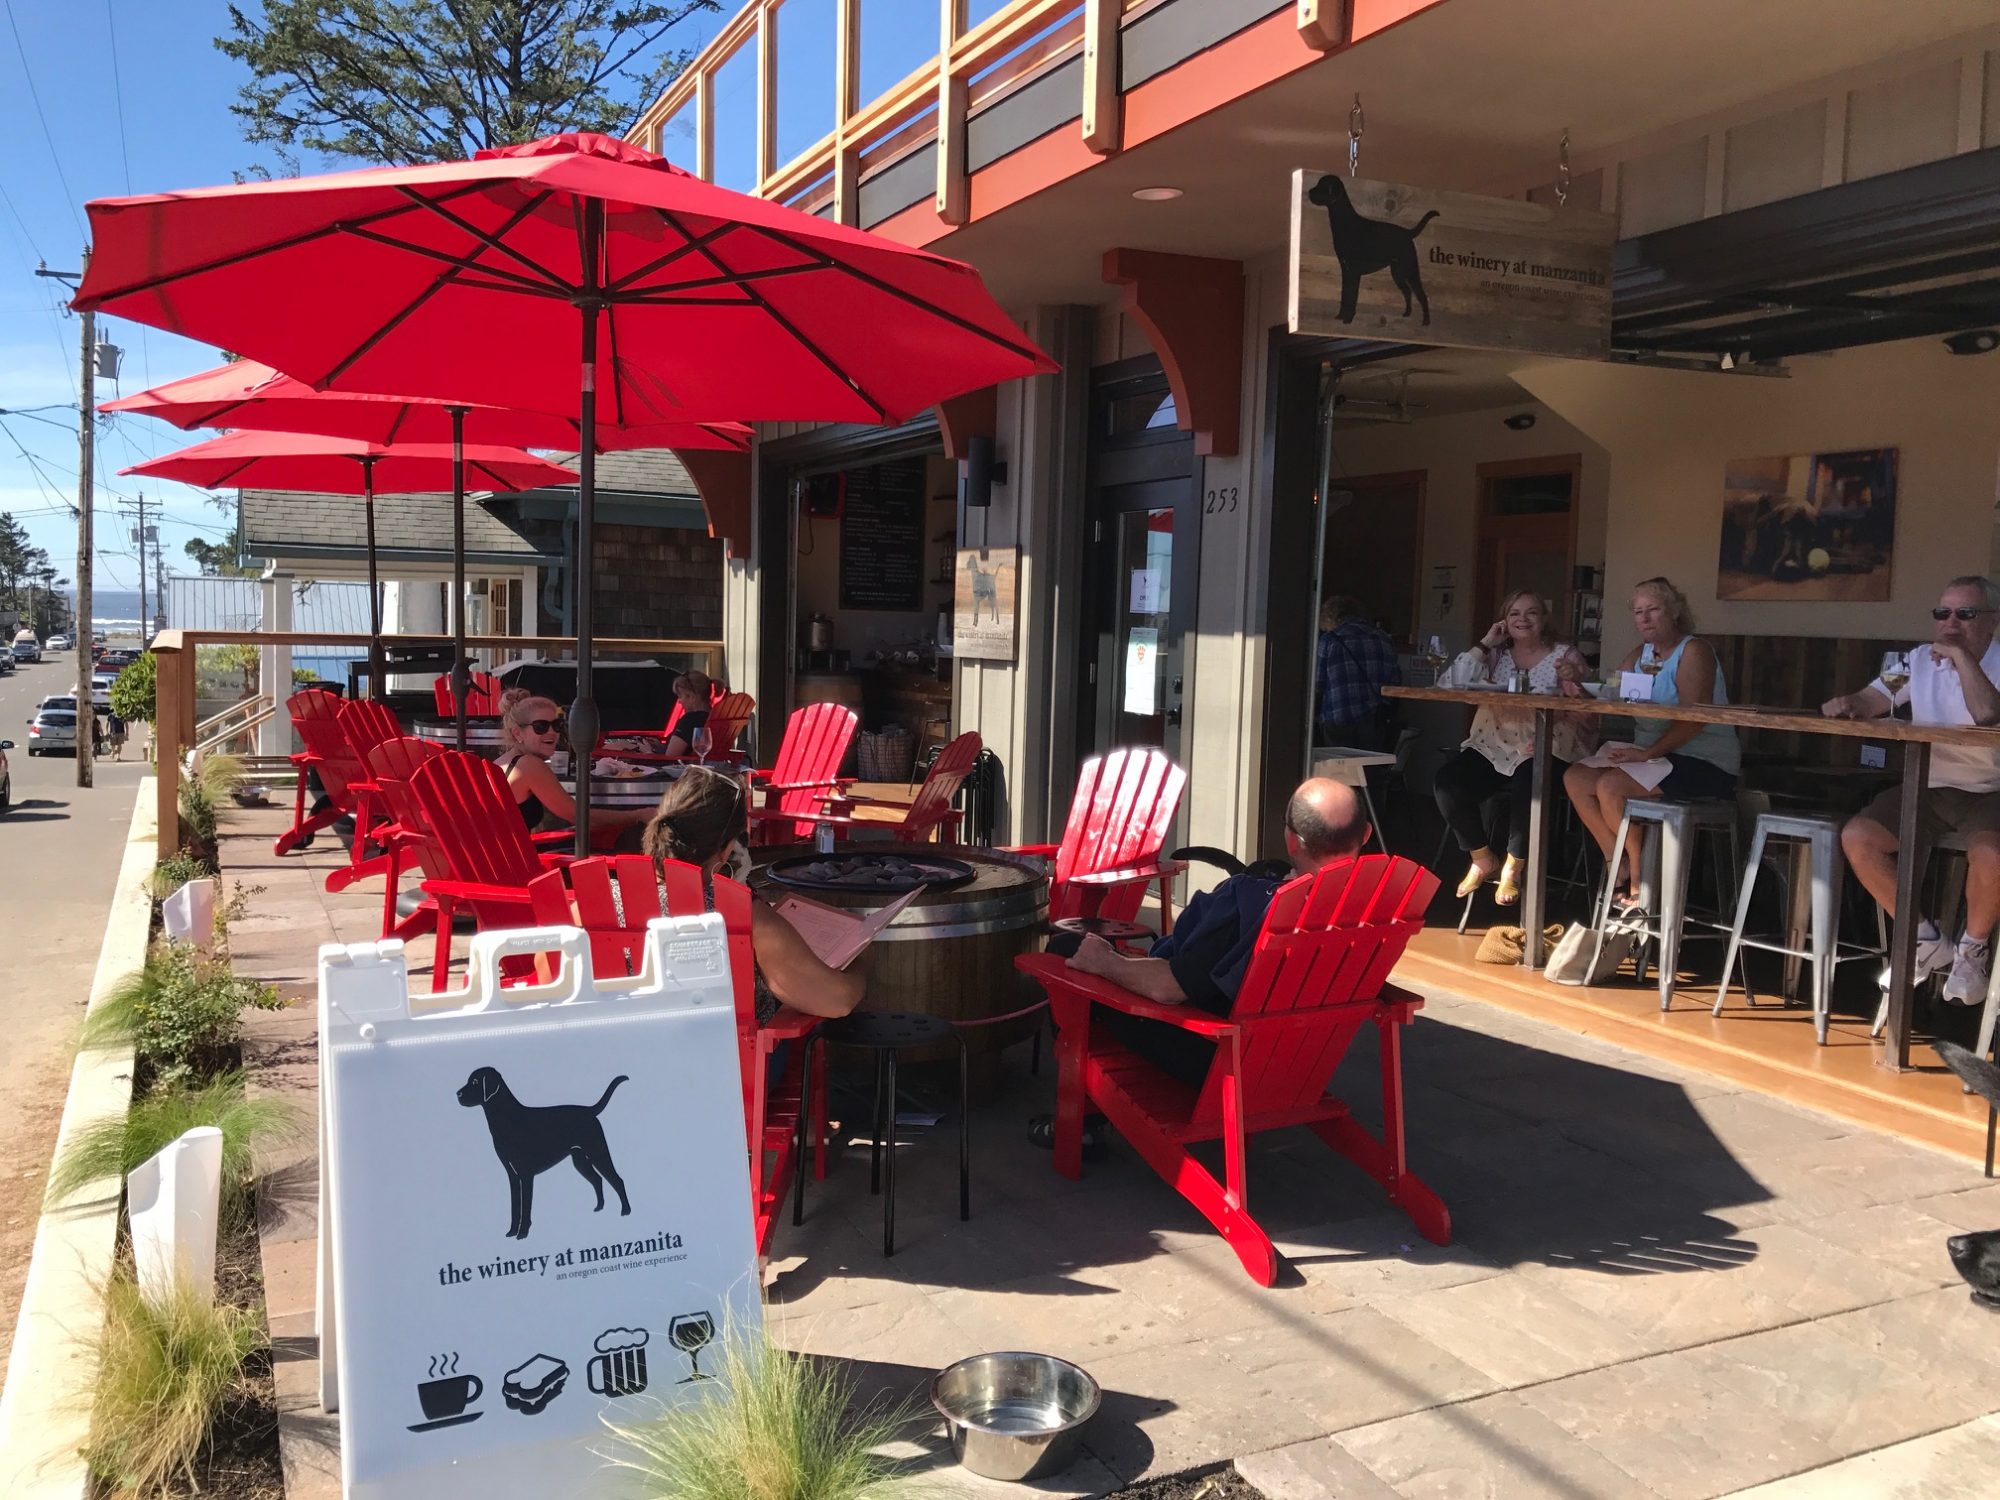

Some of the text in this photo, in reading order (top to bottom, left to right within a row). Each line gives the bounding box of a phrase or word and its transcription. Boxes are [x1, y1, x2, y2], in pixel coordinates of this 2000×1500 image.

[1430, 246, 1606, 286] the winery at manzanita
[1206, 487, 1238, 514] 253
[438, 1231, 684, 1286] the winery at manzanita
[556, 1252, 689, 1281] an oregon coast wine experience
